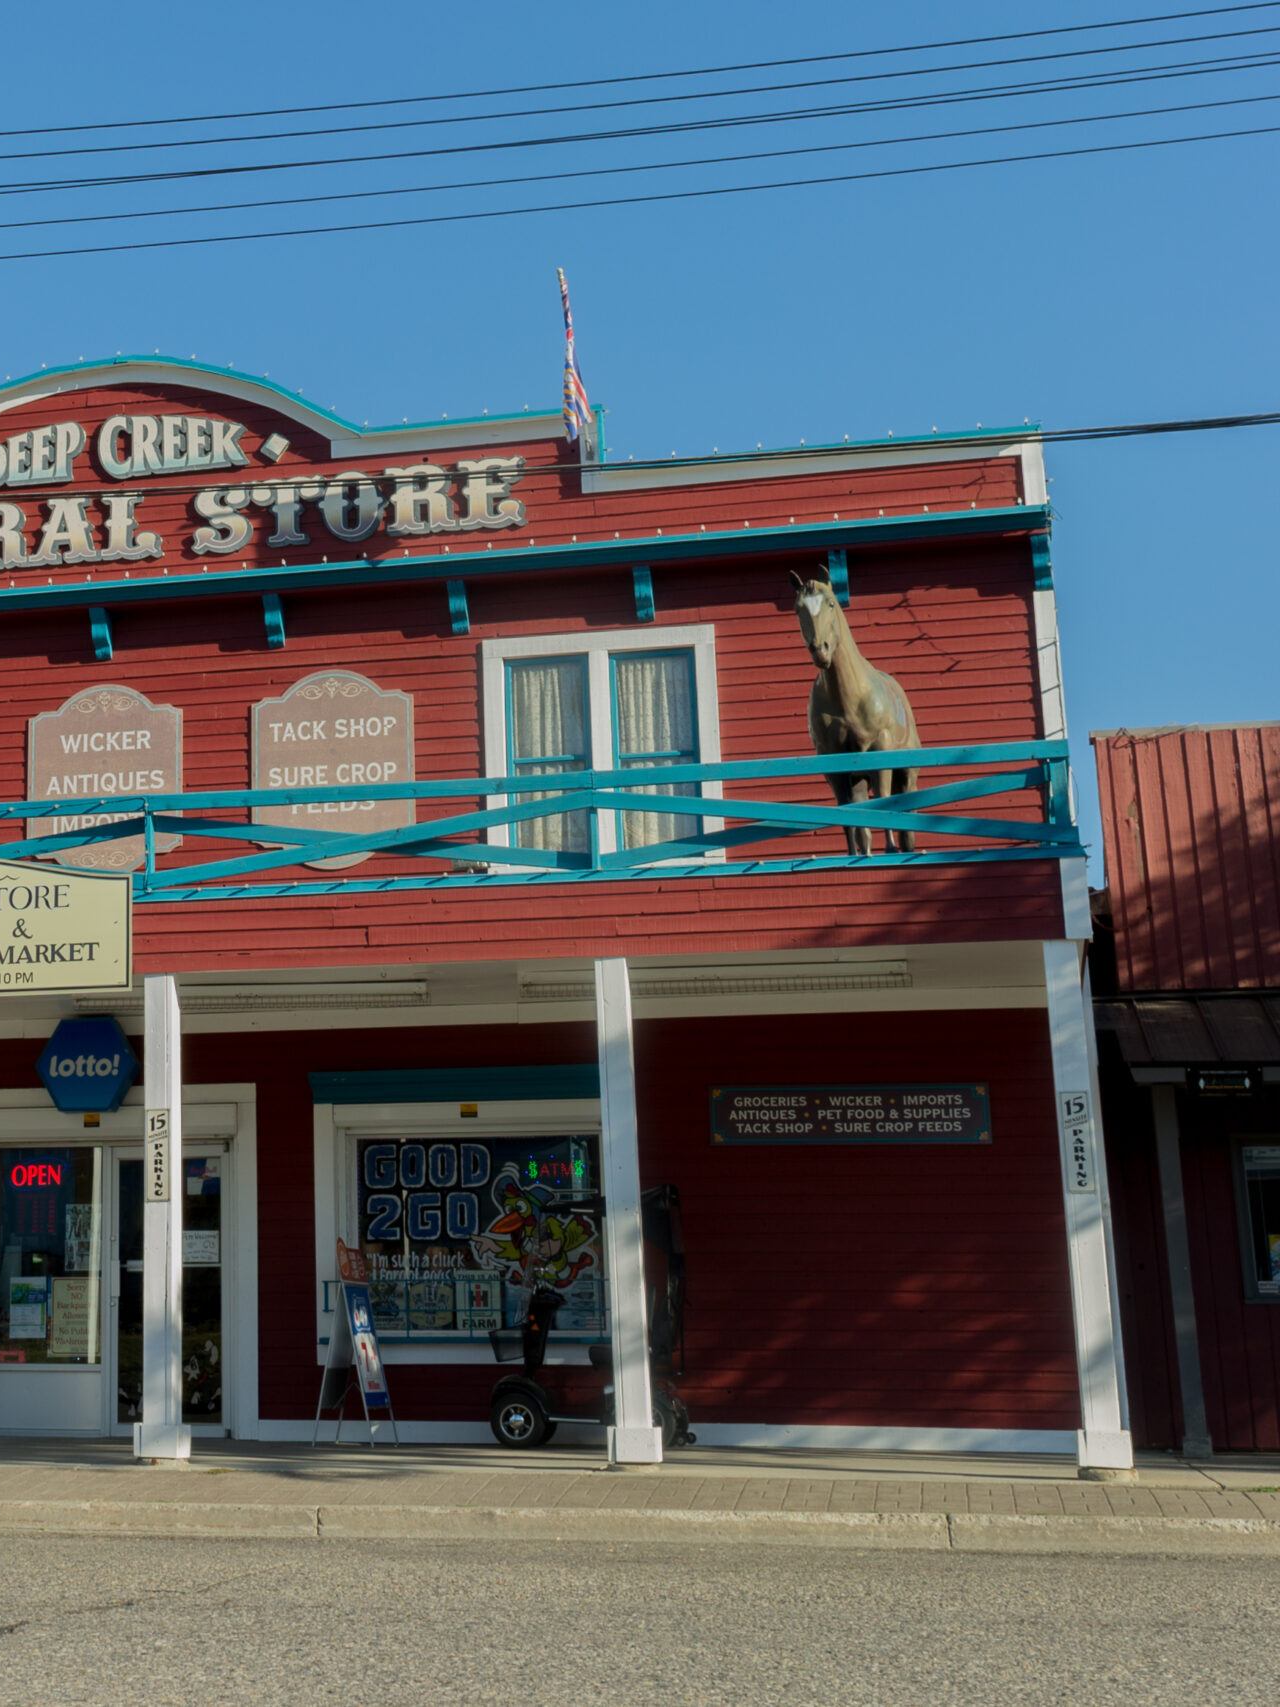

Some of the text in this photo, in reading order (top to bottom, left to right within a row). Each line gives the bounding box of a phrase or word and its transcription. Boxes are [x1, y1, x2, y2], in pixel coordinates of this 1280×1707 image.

[98, 414, 250, 480] CREEK
[191, 455, 527, 555] STORE
[269, 716, 397, 743] TACK SHOP
[60, 730, 151, 754] WICKER
[46, 770, 165, 796] ANTIQUES
[269, 761, 397, 787] SURE CROP
[12, 919, 33, 939] &
[14, 971, 34, 984] PM
[49, 1053, 120, 1078] lotto!
[733, 1094, 962, 1107] GROCERIES WICKER IMPORTS
[1064, 1095, 1084, 1116] 15
[150, 1113, 166, 1131] 15
[729, 1107, 971, 1121] ANTIQUES PET FOOD & SUPPLIES
[736, 1121, 962, 1134] TACK SHOP SURE CROP FEEDS
[154, 1143, 164, 1197] PARKING
[364, 1143, 490, 1189] GOOD
[1072, 1129, 1087, 1187] PARKING
[11, 1164, 62, 1187] OPEN
[367, 1191, 479, 1241] 2GO
[421, 1255, 429, 1268] a
[432, 1251, 465, 1268] cluck
[462, 1319, 497, 1329] FARM
